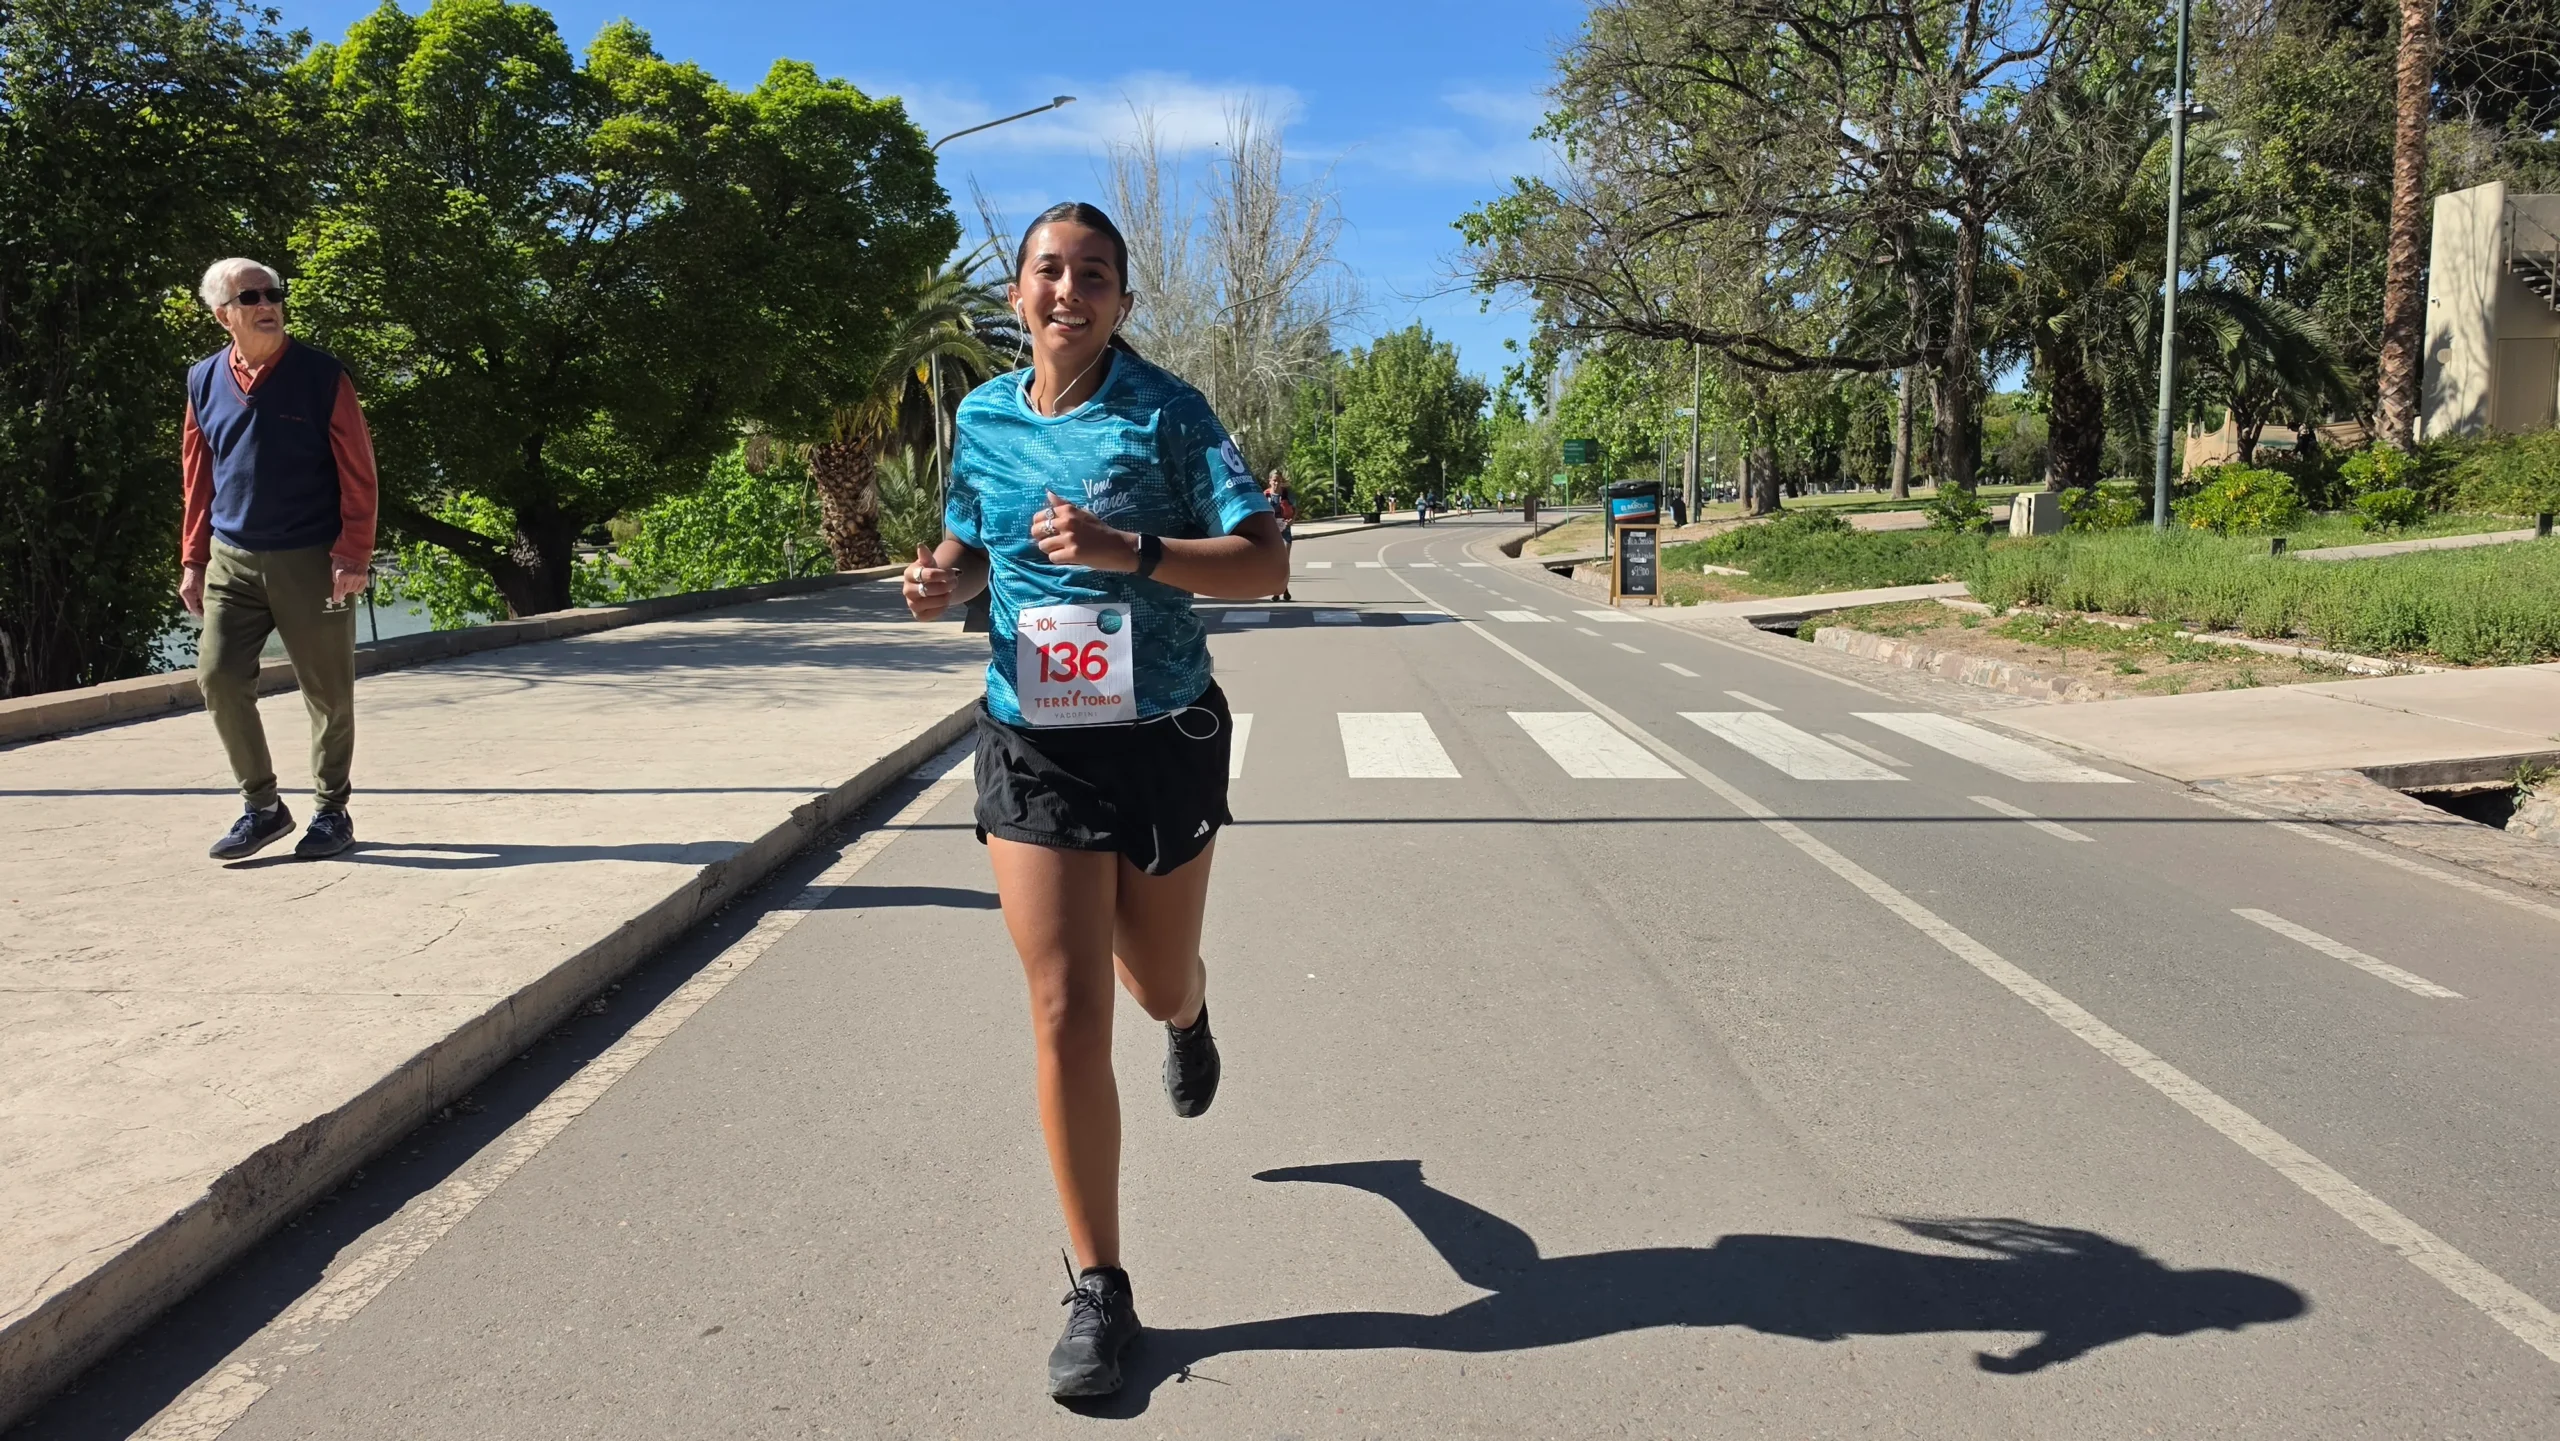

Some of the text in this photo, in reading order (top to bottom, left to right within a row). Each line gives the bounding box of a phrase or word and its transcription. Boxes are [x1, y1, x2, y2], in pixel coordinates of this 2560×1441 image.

[1082, 470, 1113, 498] Vení
[1093, 492, 1131, 514] correr
[1036, 617, 1057, 631] 10k
[1036, 640, 1109, 683] 136
